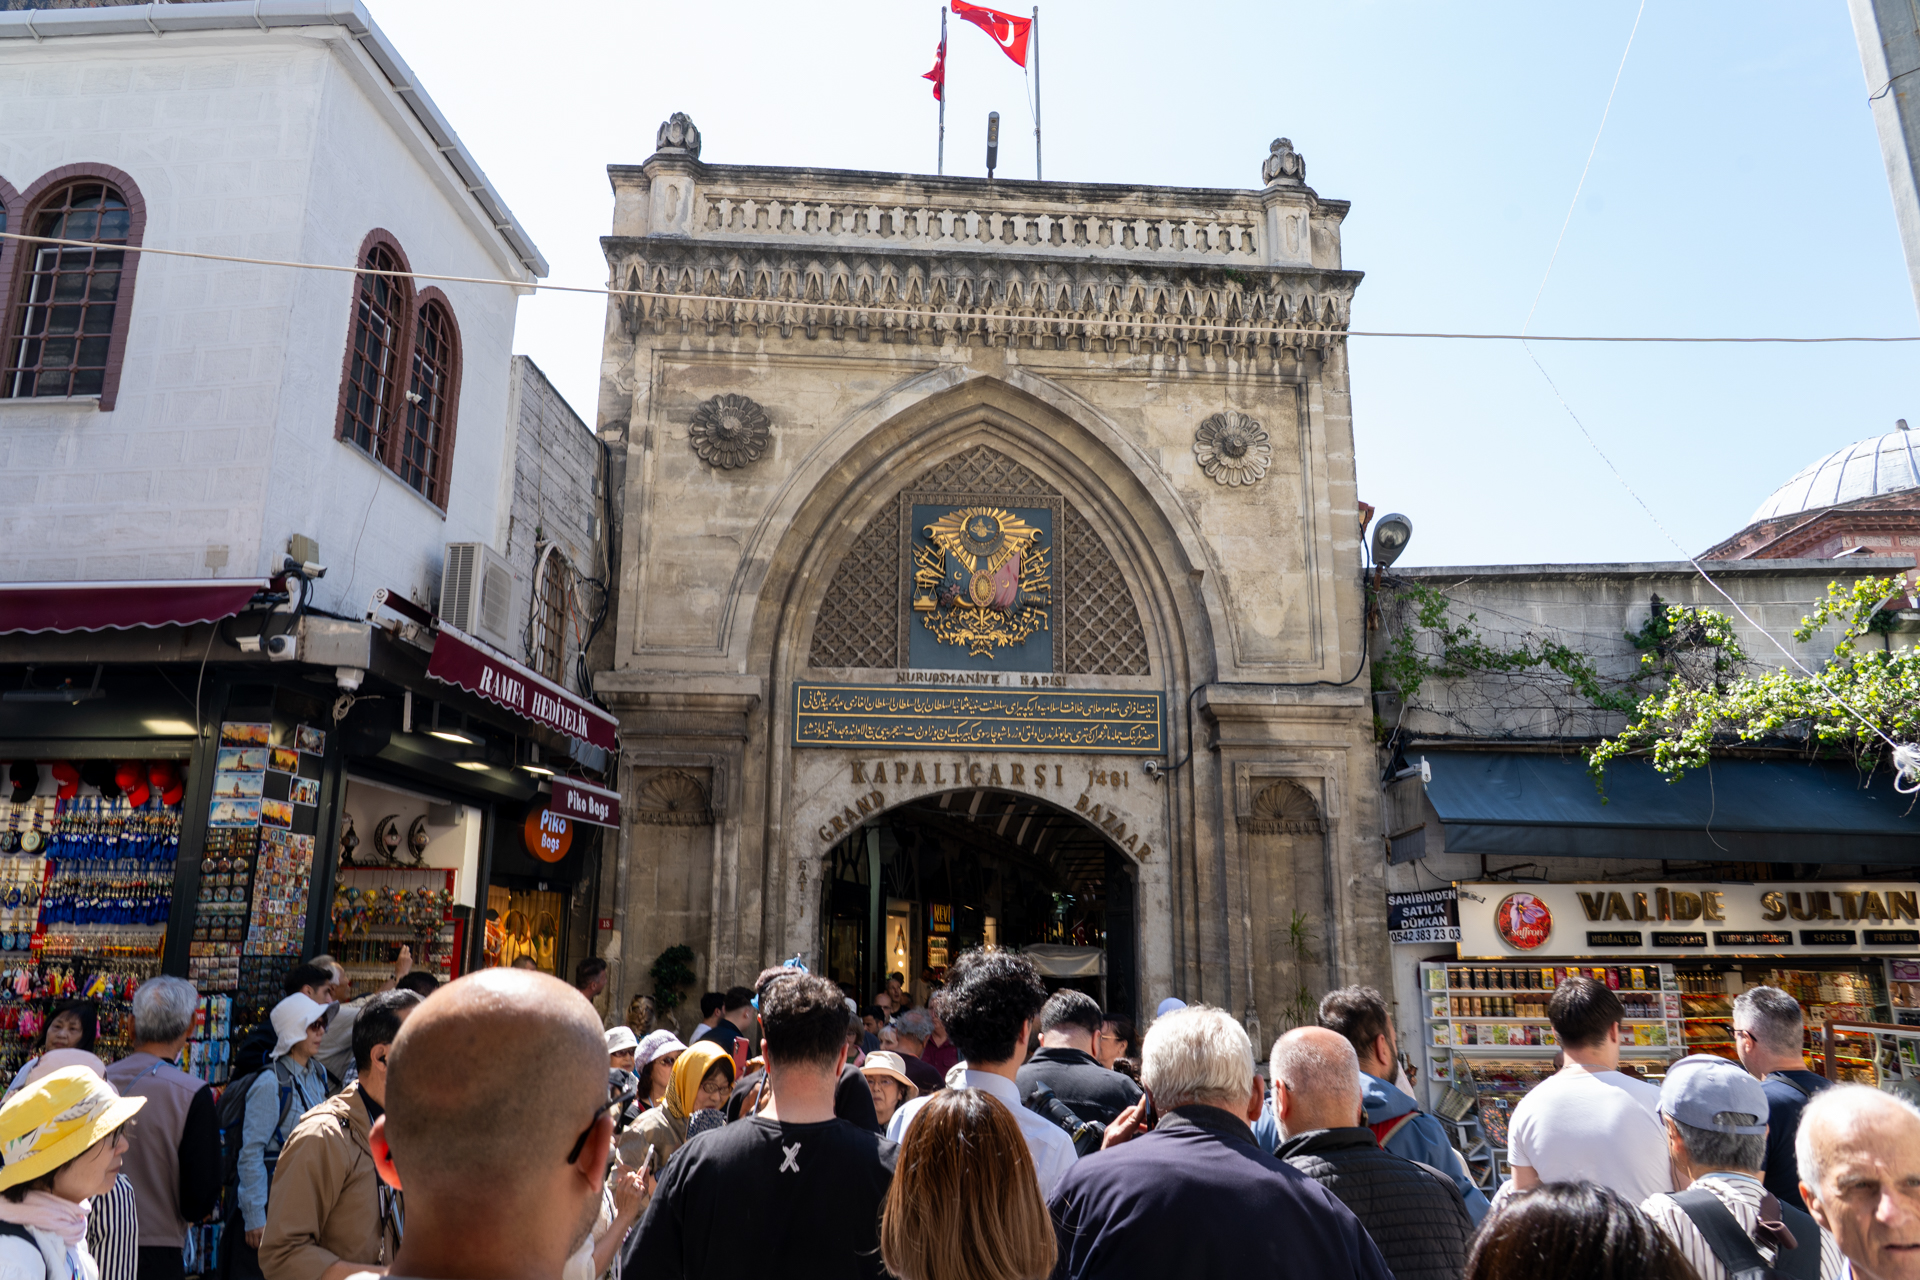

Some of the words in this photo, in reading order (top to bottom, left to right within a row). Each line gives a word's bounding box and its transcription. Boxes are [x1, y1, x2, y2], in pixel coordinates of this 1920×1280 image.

[479, 665, 525, 709] RAMFA
[531, 691, 588, 738] HEDİYELİK
[851, 761, 1063, 788] KAPALIÇARŞI
[1089, 770, 1129, 787] 1461
[567, 789, 587, 813] Piko
[588, 795, 609, 821] Bags
[540, 808, 567, 835] Piko
[818, 790, 885, 842] GRAND
[1074, 793, 1151, 864] BAZAAR
[541, 833, 560, 853] Bags
[1388, 890, 1457, 906] SAHİBİNDEN
[1576, 887, 1726, 922] VALİDE
[1761, 890, 1920, 922] SULTAN
[1402, 903, 1445, 917] SATILIK
[1400, 916, 1448, 929] DÜKKAN
[1391, 930, 1414, 942] 0542
[1416, 929, 1431, 941] 383
[1434, 929, 1446, 940] 23
[1449, 928, 1460, 940] 03
[1591, 934, 1623, 944] HERBAL
[1624, 935, 1640, 944] TEA
[1658, 935, 1704, 945] CHOCOLATE
[1720, 934, 1756, 943] TURKISH
[1756, 934, 1790, 943] DELIGHT
[1813, 933, 1848, 943] SPICES
[1873, 933, 1897, 942] FRUIT
[1898, 933, 1915, 942] TEA
